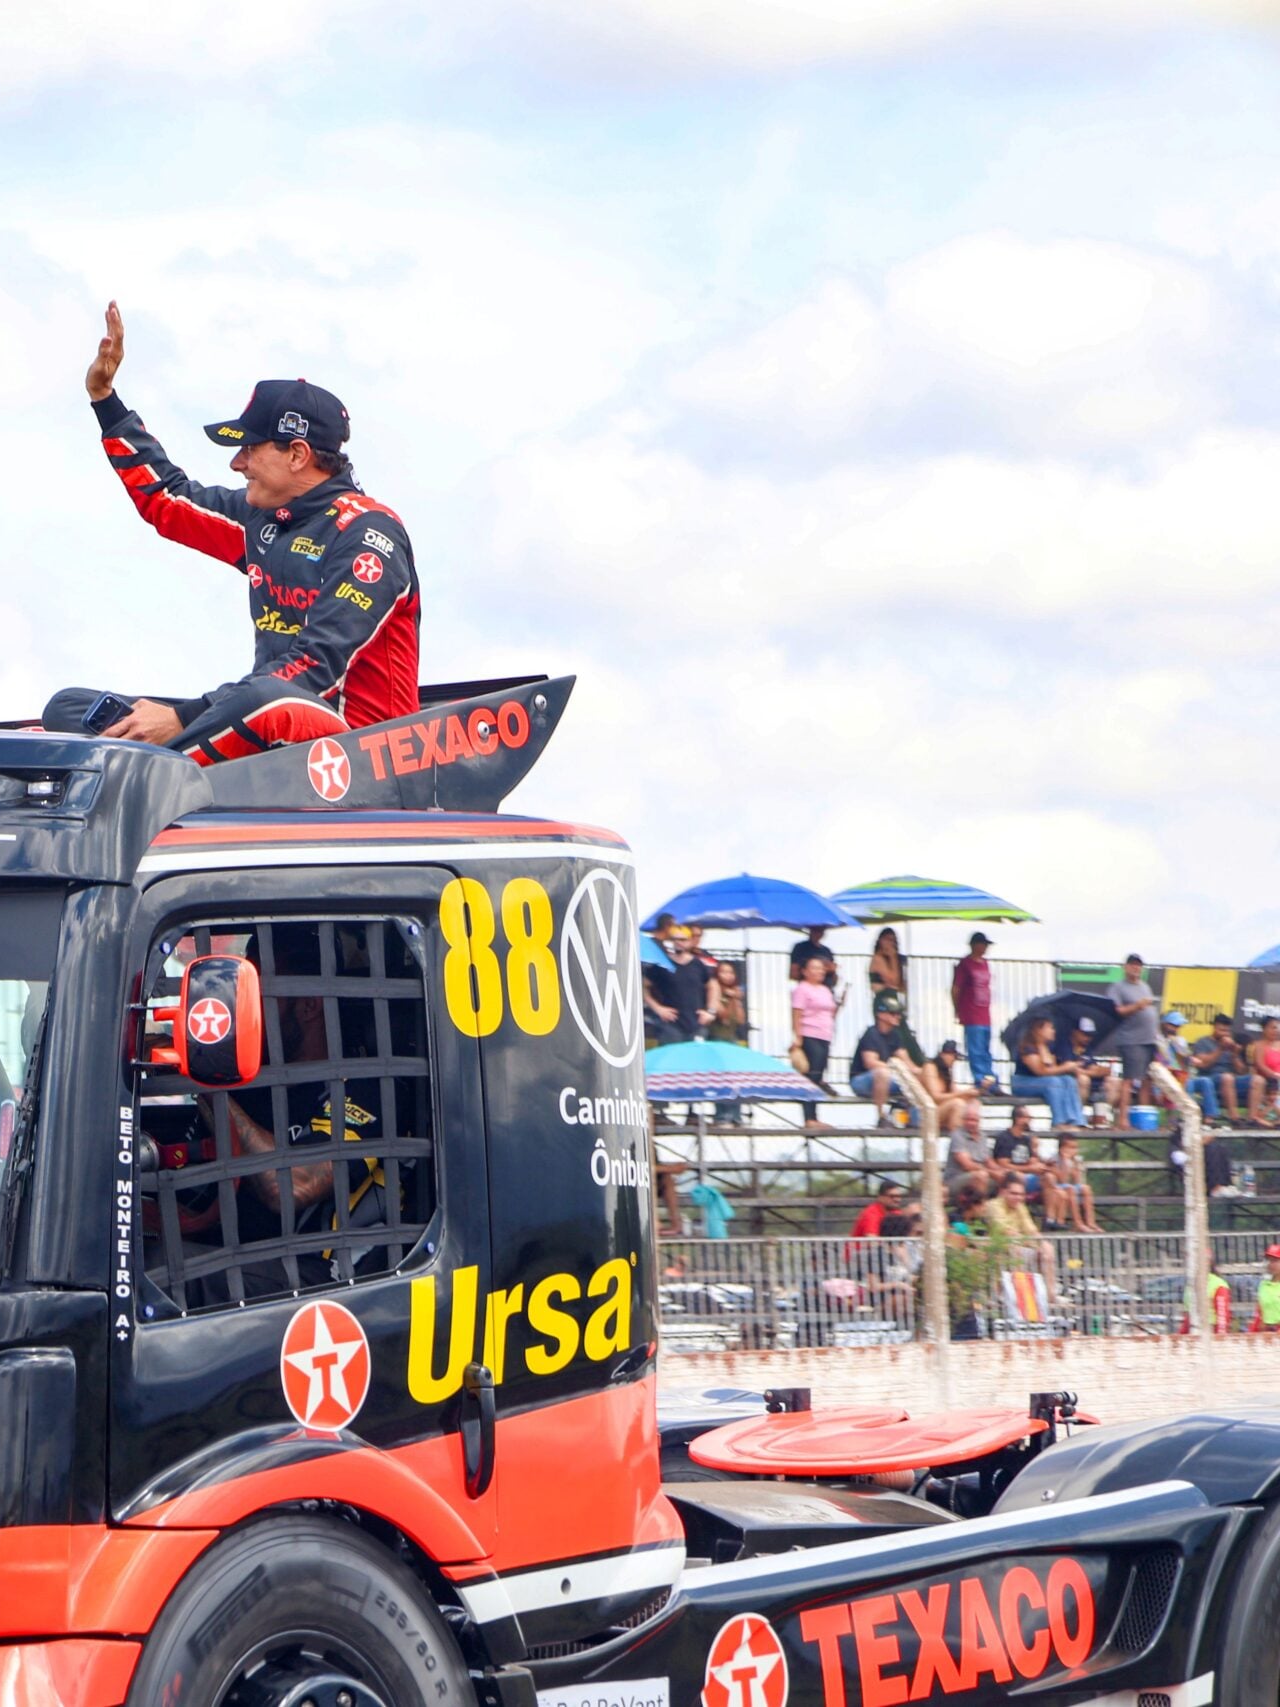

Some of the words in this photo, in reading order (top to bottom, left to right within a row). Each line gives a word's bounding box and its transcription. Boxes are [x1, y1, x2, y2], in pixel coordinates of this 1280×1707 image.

[217, 426, 245, 439] Ursa
[364, 531, 394, 554] OMP
[335, 582, 373, 611] Ursa
[359, 700, 530, 781] TEXACO
[439, 877, 561, 1037] 88
[118, 1106, 134, 1165] BETO
[590, 1138, 650, 1188] Ônibus
[116, 1180, 133, 1298] MONTEIRO
[799, 1558, 1095, 1707] TEXACO
